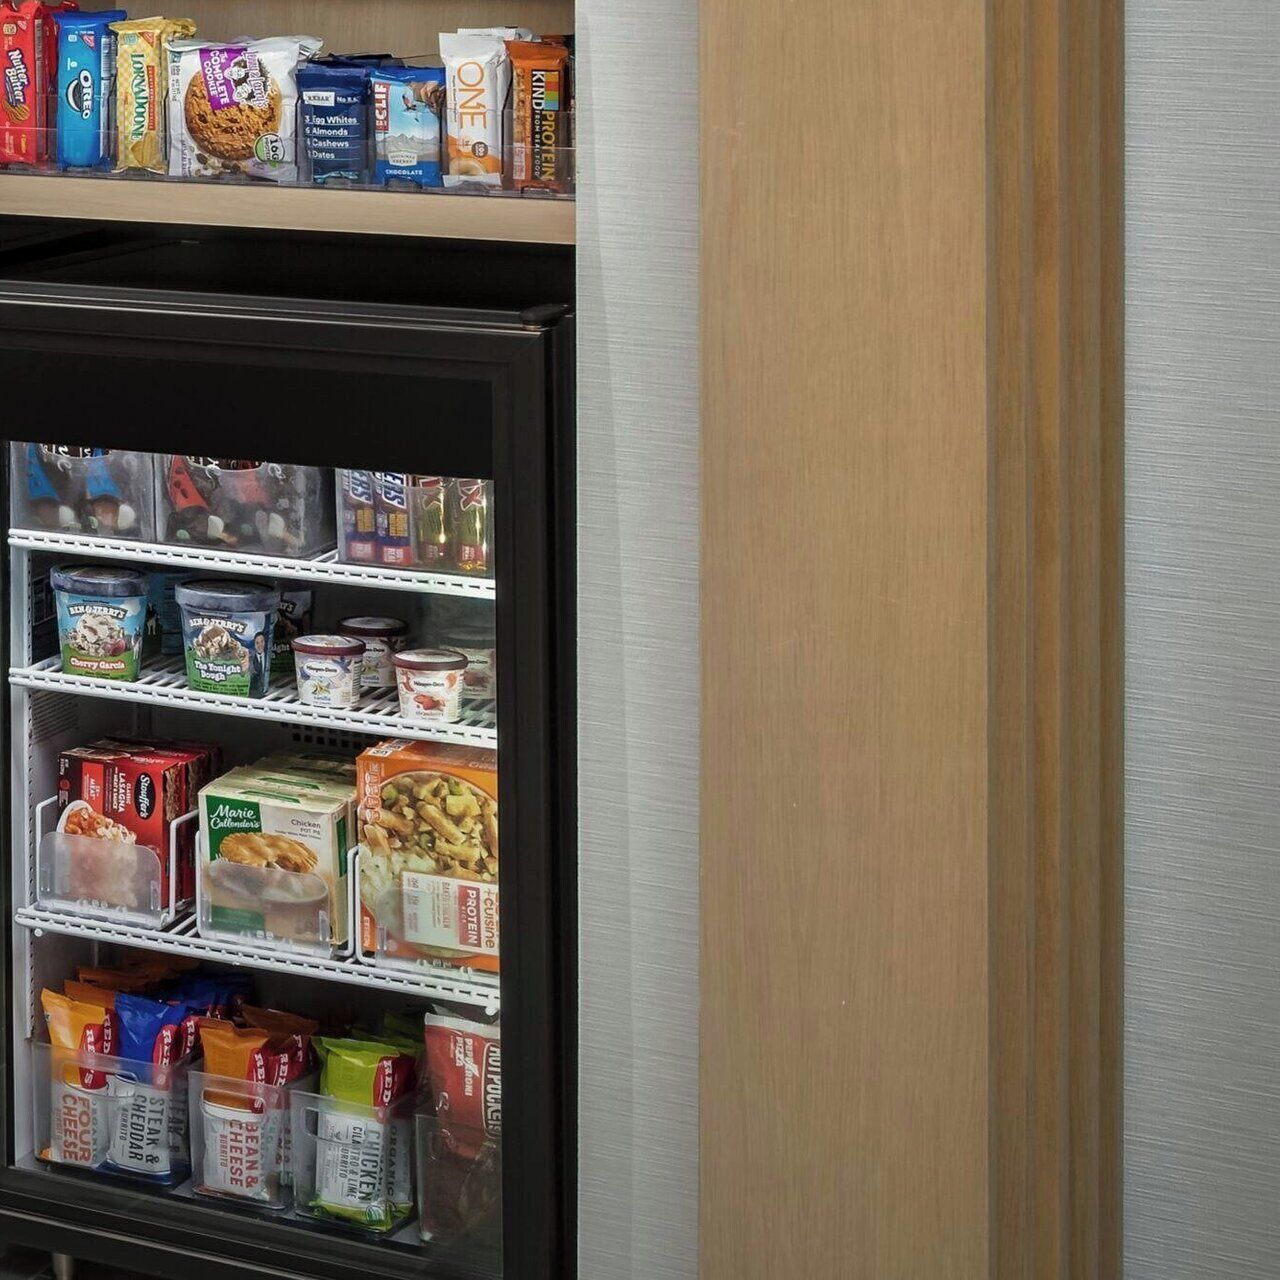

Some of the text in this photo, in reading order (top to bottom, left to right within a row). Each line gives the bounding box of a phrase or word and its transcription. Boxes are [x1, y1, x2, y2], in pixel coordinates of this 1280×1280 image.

[6, 68, 25, 102] Butter
[8, 49, 28, 86] Nutter
[203, 60, 217, 97] COOKIE
[209, 50, 230, 105] COMPLETE
[78, 69, 93, 120] OREO
[376, 83, 389, 118] CLIF
[457, 61, 488, 130] ONE
[532, 70, 546, 111] KIND
[312, 115, 357, 124] Egg Whites
[312, 127, 349, 136] Almonds
[269, 138, 280, 161] 16G
[311, 139, 350, 148] Cashews
[311, 150, 336, 159] Dates
[540, 110, 556, 181] PROTEIN
[69, 606, 86, 616] BEN
[70, 657, 126, 670] Cherry Garcia
[194, 660, 242, 676] The Tonight
[200, 670, 226, 682] Dough
[117, 771, 127, 813] LASAGNA
[138, 773, 151, 819] Stouffer's
[210, 804, 257, 819] Marie
[210, 818, 262, 831] Callender's
[290, 819, 322, 830] Chicken
[466, 889, 478, 945] PROTEIN
[62, 1094, 79, 1161] CHEESE
[77, 1096, 92, 1162] FOUR
[129, 1094, 147, 1162] CHEDDAR
[146, 1097, 166, 1165] STEAK &
[228, 1118, 244, 1187] CHEESE
[244, 1120, 260, 1189] BEAN &
[358, 1129, 382, 1201] CHICKEN
